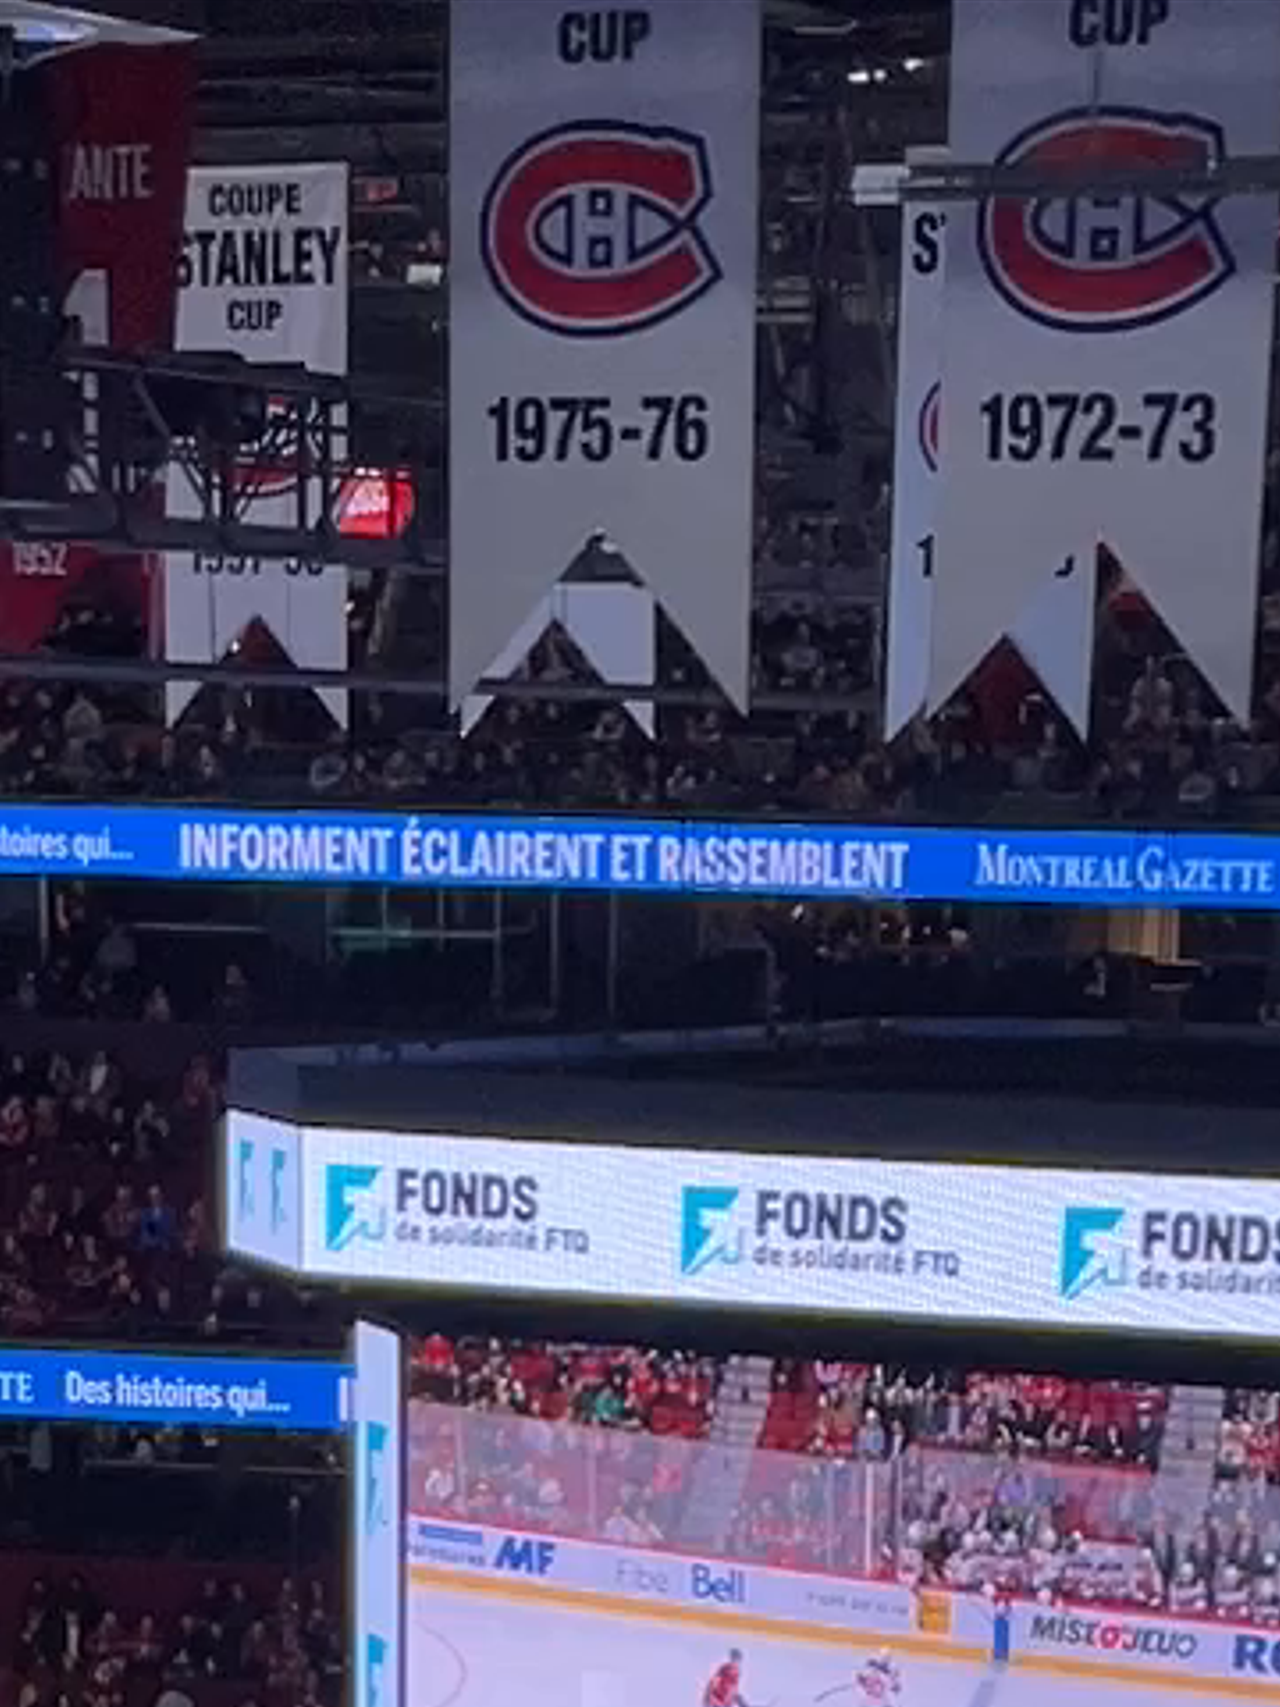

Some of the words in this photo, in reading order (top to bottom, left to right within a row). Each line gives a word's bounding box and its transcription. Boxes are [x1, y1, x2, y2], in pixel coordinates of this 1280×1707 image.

[558, 11, 652, 64] CUP
[1069, 0, 1168, 46] CUP
[207, 183, 302, 217] COUPE
[176, 225, 342, 288] STANLEY
[227, 301, 283, 332] CUP
[487, 395, 709, 463] 1975-76
[978, 390, 1217, 463] 1972-73
[180, 822, 394, 876] INFORMENT
[402, 816, 599, 880] ÉCLAIRENT
[610, 835, 652, 884] ET
[658, 836, 909, 890] RASSEMBLENT
[976, 841, 1133, 891] MONTREAL
[1135, 847, 1276, 894] GAZETTE
[396, 1167, 539, 1222] FONDS
[756, 1189, 908, 1243] FONDS
[395, 1221, 423, 1245] de
[428, 1221, 538, 1252] solidarité
[545, 1229, 590, 1255] FTQ
[752, 1244, 782, 1267] de
[785, 1244, 907, 1275] solidarité
[914, 1252, 960, 1278] FTQ
[1137, 1265, 1171, 1290] de
[66, 1371, 113, 1405] Des
[117, 1373, 222, 1410] histoires
[691, 1564, 745, 1603] Bell
